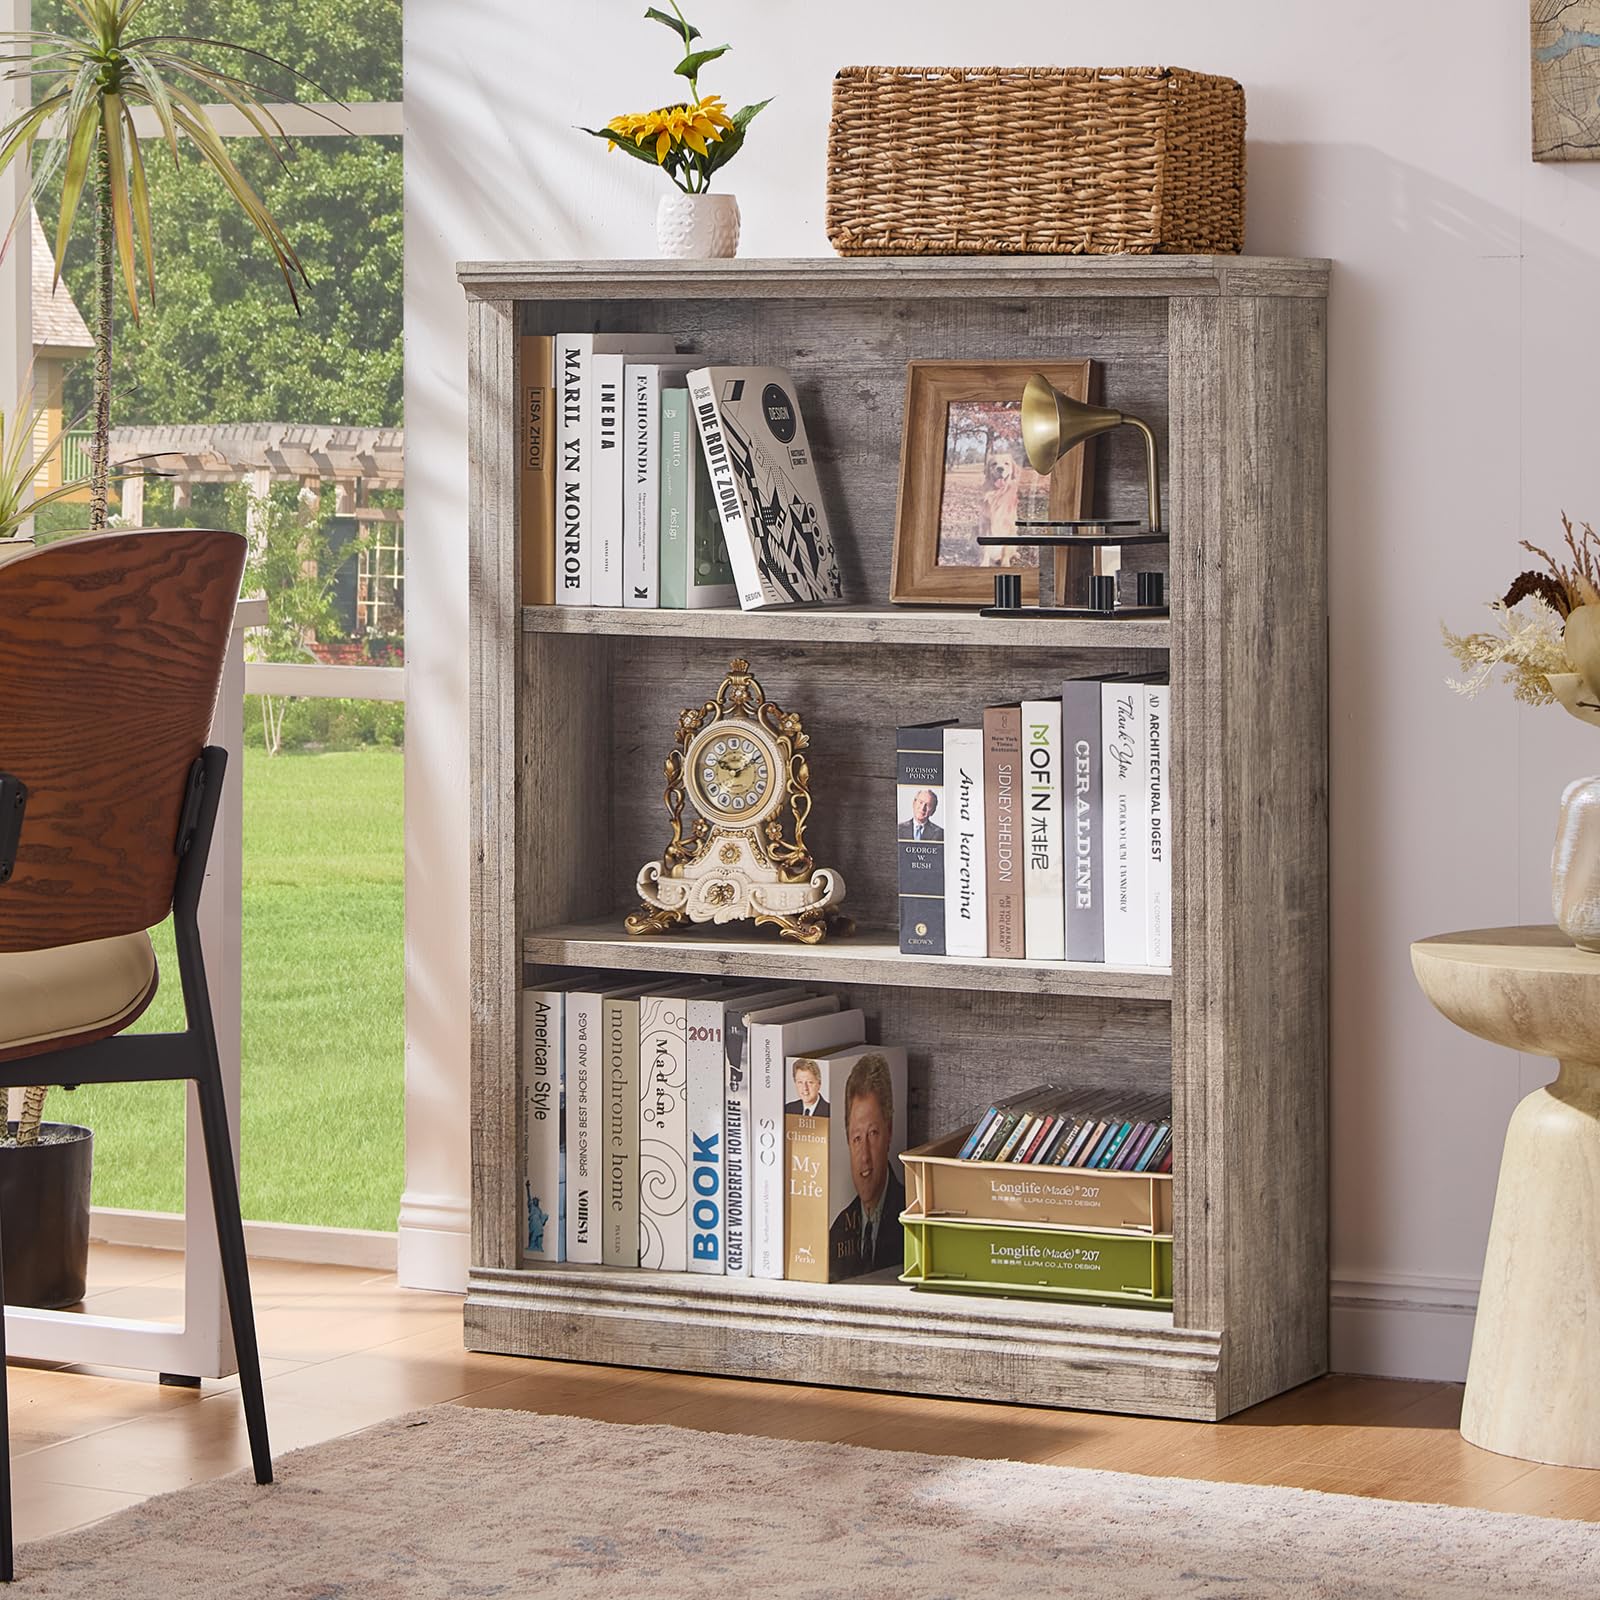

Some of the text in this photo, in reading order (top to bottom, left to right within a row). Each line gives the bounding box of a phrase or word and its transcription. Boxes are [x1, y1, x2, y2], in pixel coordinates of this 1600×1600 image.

[529, 391, 541, 466] LISA ZHOU
[601, 384, 615, 449] INEDIA
[637, 375, 648, 484] FASHIONINDIA
[673, 431, 681, 467] muuto
[698, 402, 741, 522] DIE ROTE ZONE
[564, 482, 580, 589] MONROE
[669, 508, 680, 540] design
[1116, 695, 1135, 744] Thank
[905, 766, 938, 774] DECISION
[909, 772, 935, 780] POINTS
[1109, 742, 1134, 780] You
[1150, 713, 1160, 816] ARCHITECTURAL
[959, 767, 975, 920] Anna karenina
[998, 763, 1012, 883] SIDNEY SHELDON
[1151, 817, 1162, 863] DIGEST
[905, 846, 938, 854] GEORGE
[999, 899, 1005, 907] OF
[688, 1026, 721, 1042] 2011
[764, 1038, 772, 1074] magazine
[530, 1000, 551, 1120] American Style
[611, 1008, 628, 1147] monochrome
[656, 1038, 668, 1129] Madame
[577, 1012, 589, 1244] FASHION SPRING'S BEST SHOES AND BAGS
[760, 1118, 775, 1167] COS
[798, 1118, 817, 1129] Bill
[611, 1152, 628, 1212] home
[727, 1099, 743, 1271] CREATE WONDERFUL HOMELIFE
[790, 1178, 823, 1198] Life
[792, 1155, 821, 1178] My
[990, 1180, 1041, 1196] Longlife
[1081, 1186, 1100, 1198] 207
[692, 1130, 719, 1261] BOOK
[990, 1243, 1041, 1259] Longlife
[1081, 1250, 1100, 1261] 207
[1074, 1263, 1101, 1271] DESIGN
